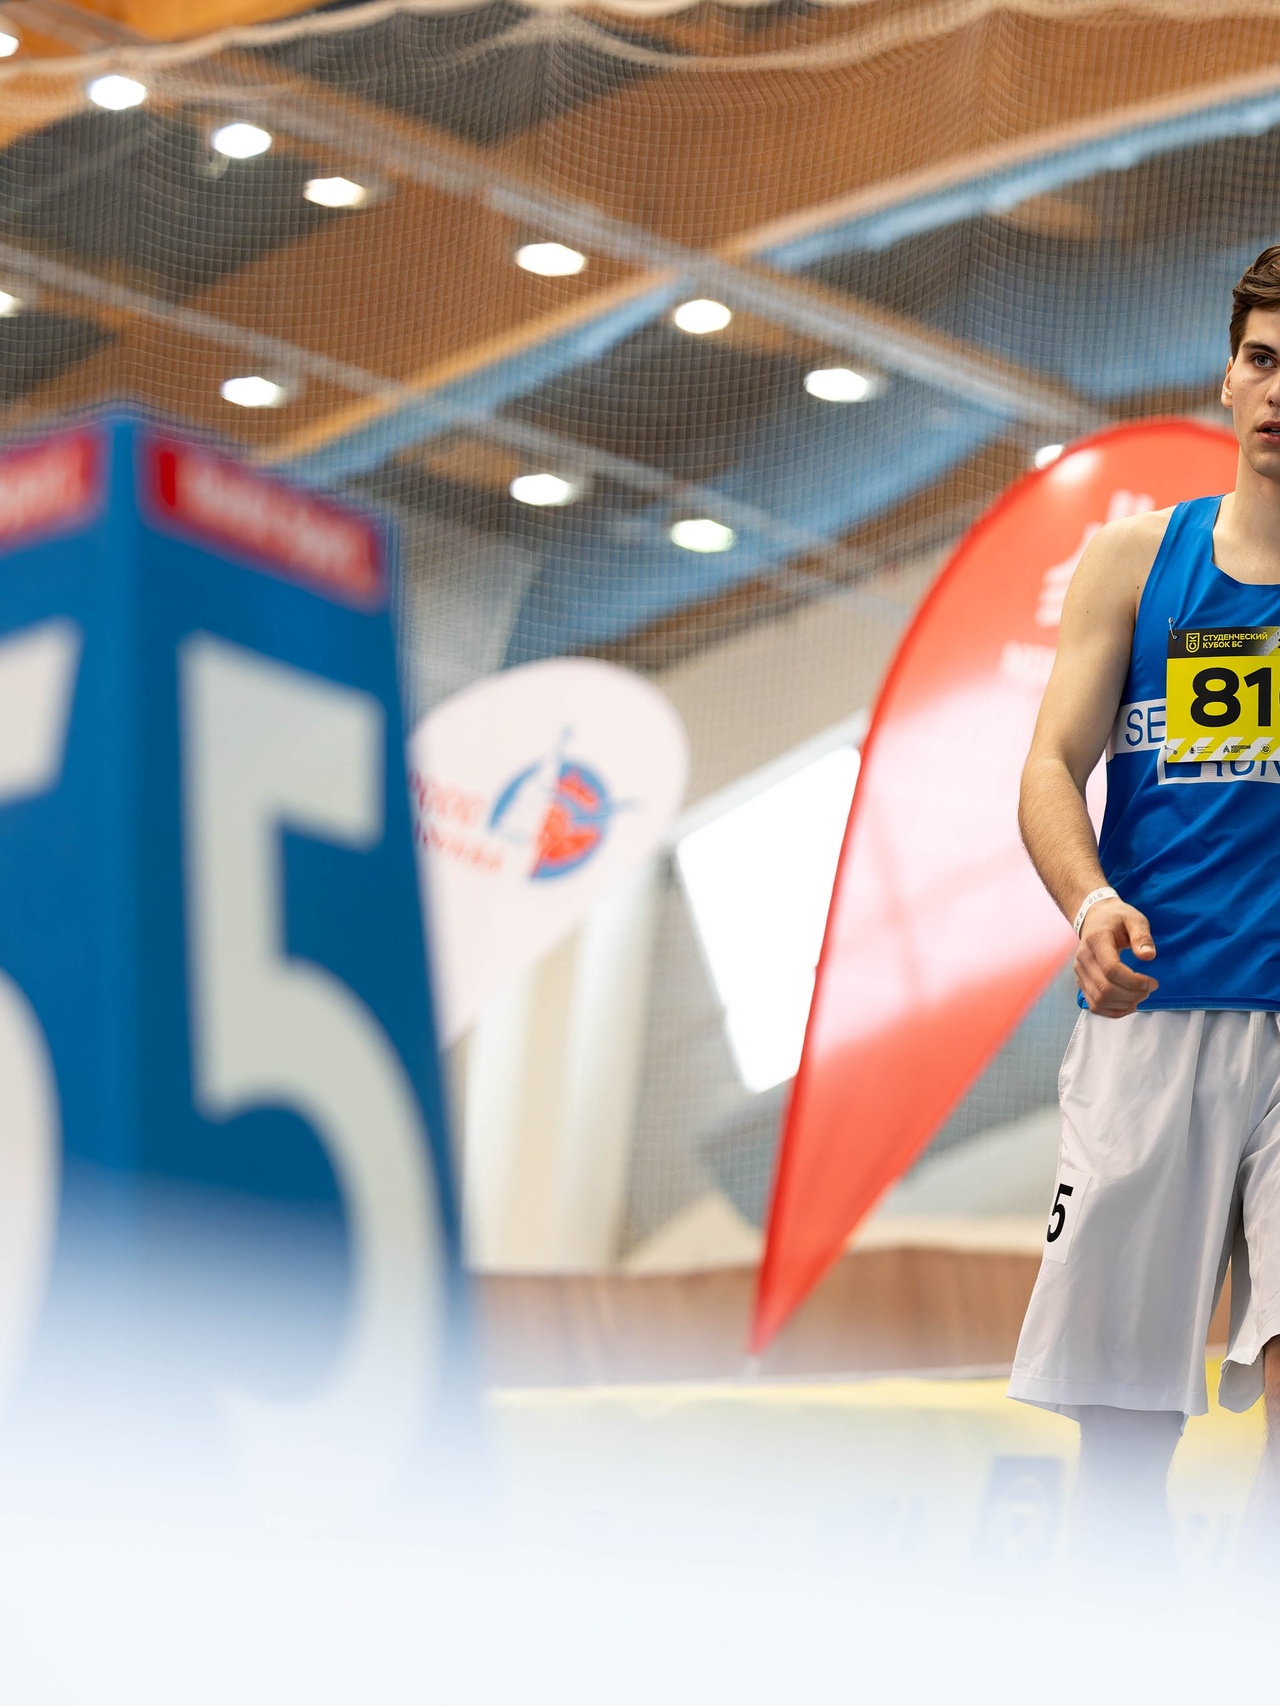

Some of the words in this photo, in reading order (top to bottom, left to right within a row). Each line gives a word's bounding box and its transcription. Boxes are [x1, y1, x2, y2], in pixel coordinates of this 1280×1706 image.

[1202, 631, 1268, 641] СТУДЕНЧЕСКИЙ
[1202, 641, 1230, 649] КУБОК
[1231, 640, 1243, 648] БС
[182, 630, 448, 1440] 5
[1046, 1183, 1074, 1243] 5
